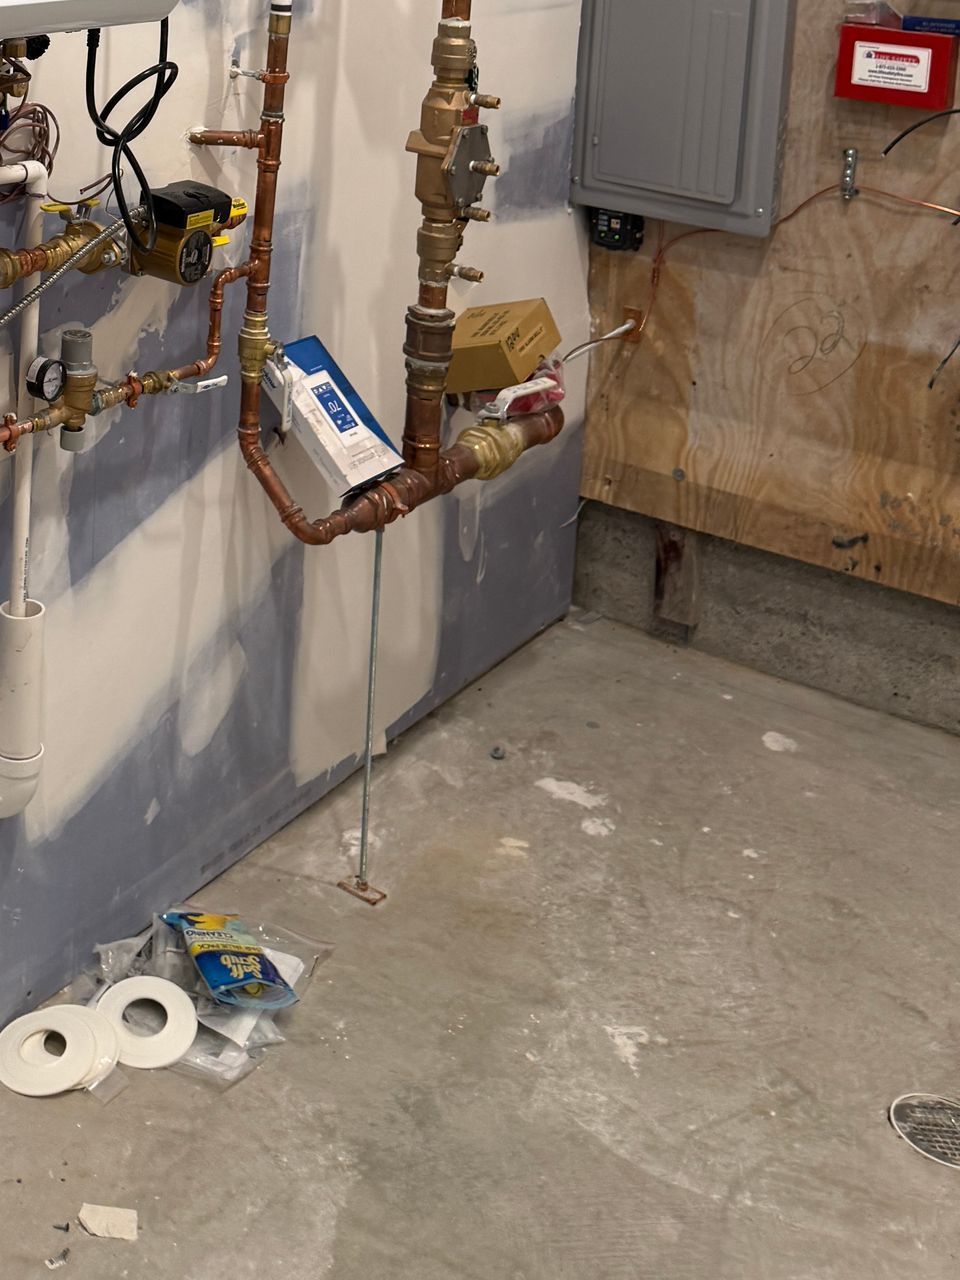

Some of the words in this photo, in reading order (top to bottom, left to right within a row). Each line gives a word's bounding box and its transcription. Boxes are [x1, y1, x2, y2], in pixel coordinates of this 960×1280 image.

[185, 930, 233, 940] CLEANING
[220, 953, 260, 968] Scrub
[230, 965, 262, 980] Soft
